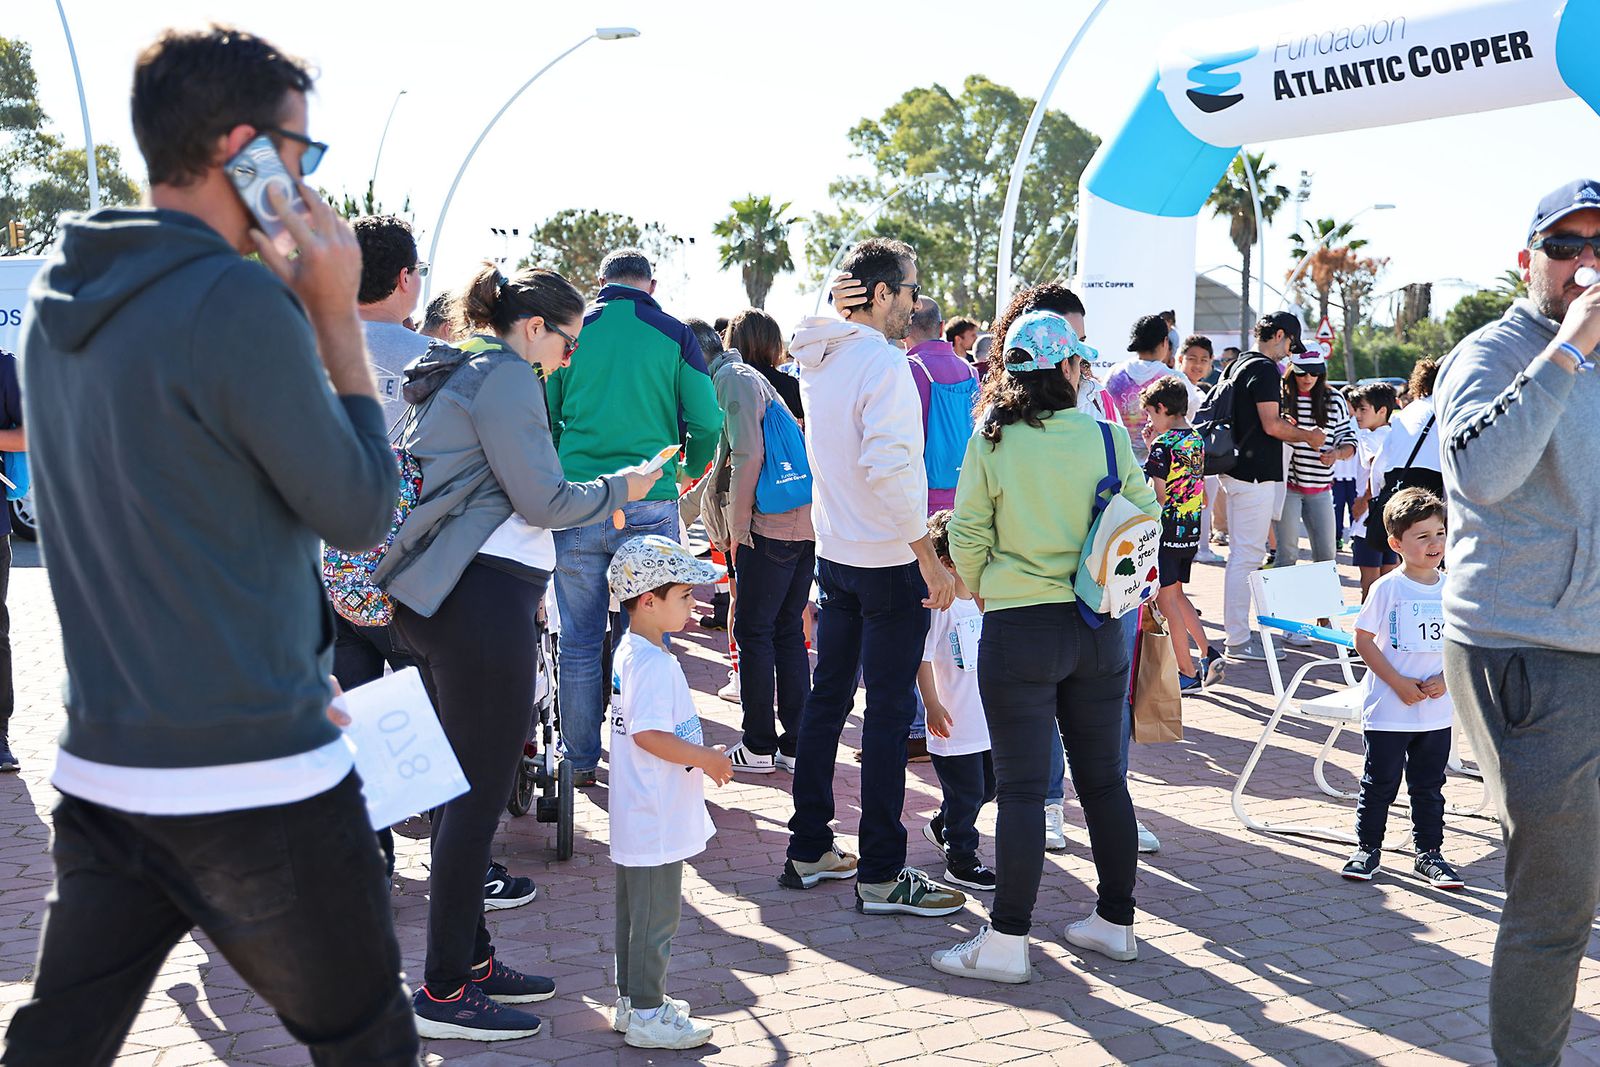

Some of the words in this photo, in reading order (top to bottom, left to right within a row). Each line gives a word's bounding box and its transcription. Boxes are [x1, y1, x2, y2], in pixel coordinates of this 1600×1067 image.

[1273, 55, 1405, 100] ATLANTIC
[1408, 30, 1533, 78] COPPER
[1137, 547, 1156, 567] green
[1124, 579, 1140, 596] red
